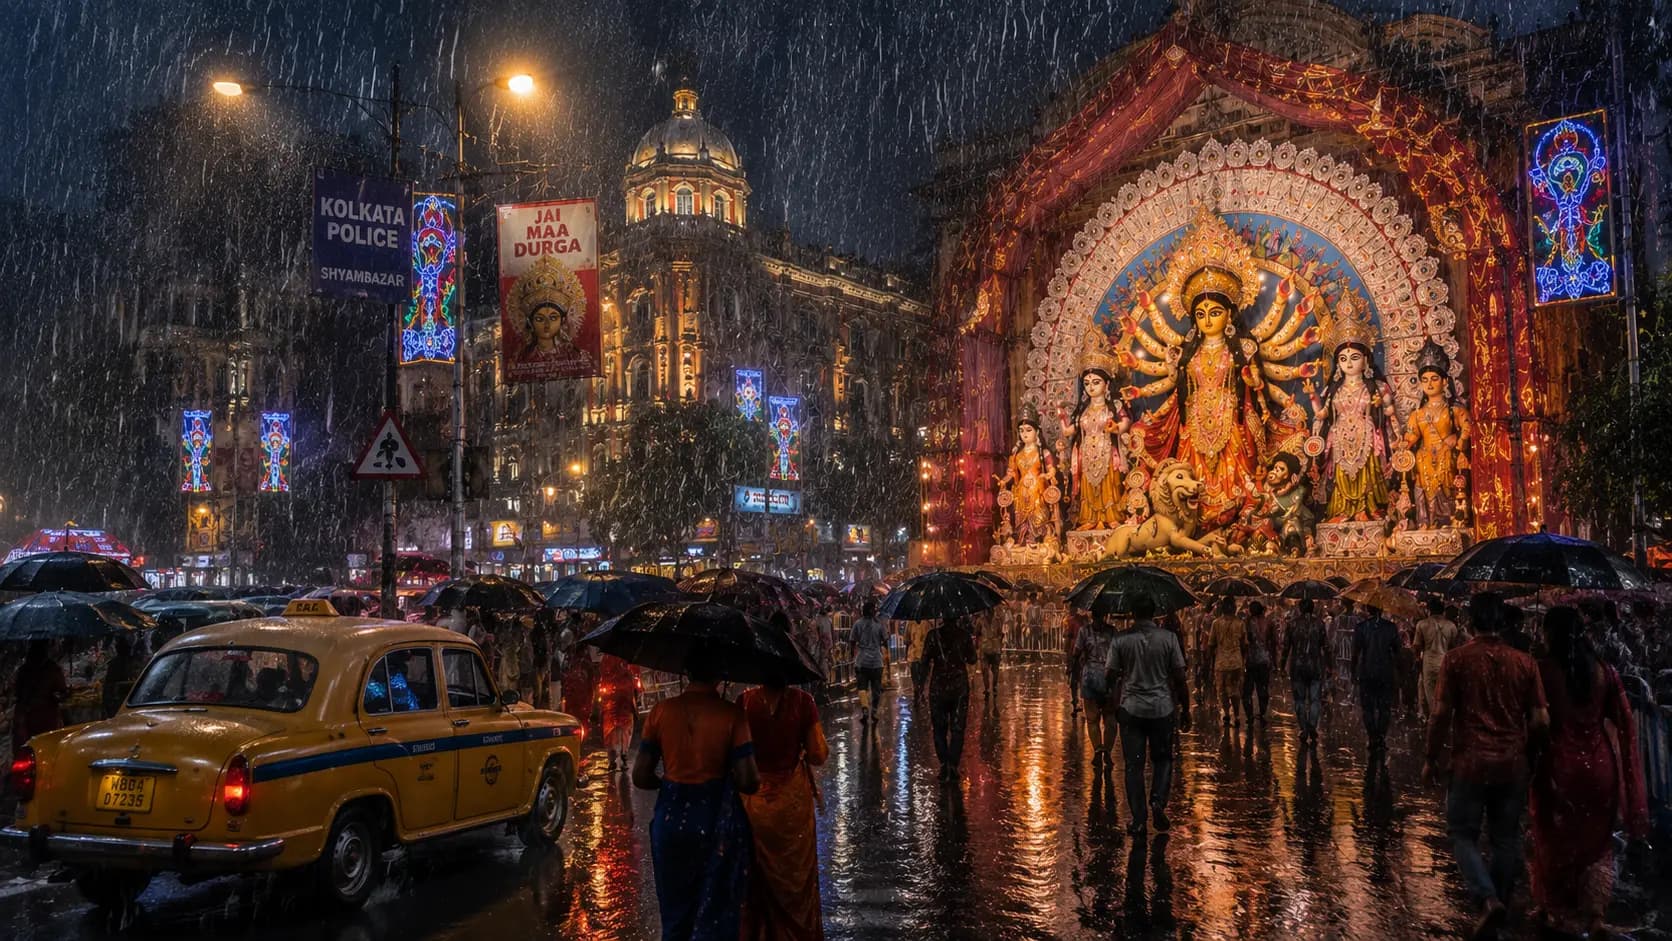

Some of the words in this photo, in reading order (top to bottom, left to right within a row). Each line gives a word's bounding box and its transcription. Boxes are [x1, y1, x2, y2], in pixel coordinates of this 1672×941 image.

[321, 197, 405, 226] KOLKATA
[534, 208, 561, 224] JAI
[327, 222, 399, 249] POLICE
[526, 224, 569, 240] MAA
[514, 238, 582, 258] DURGA
[321, 267, 405, 287] SHYAMBAZAR
